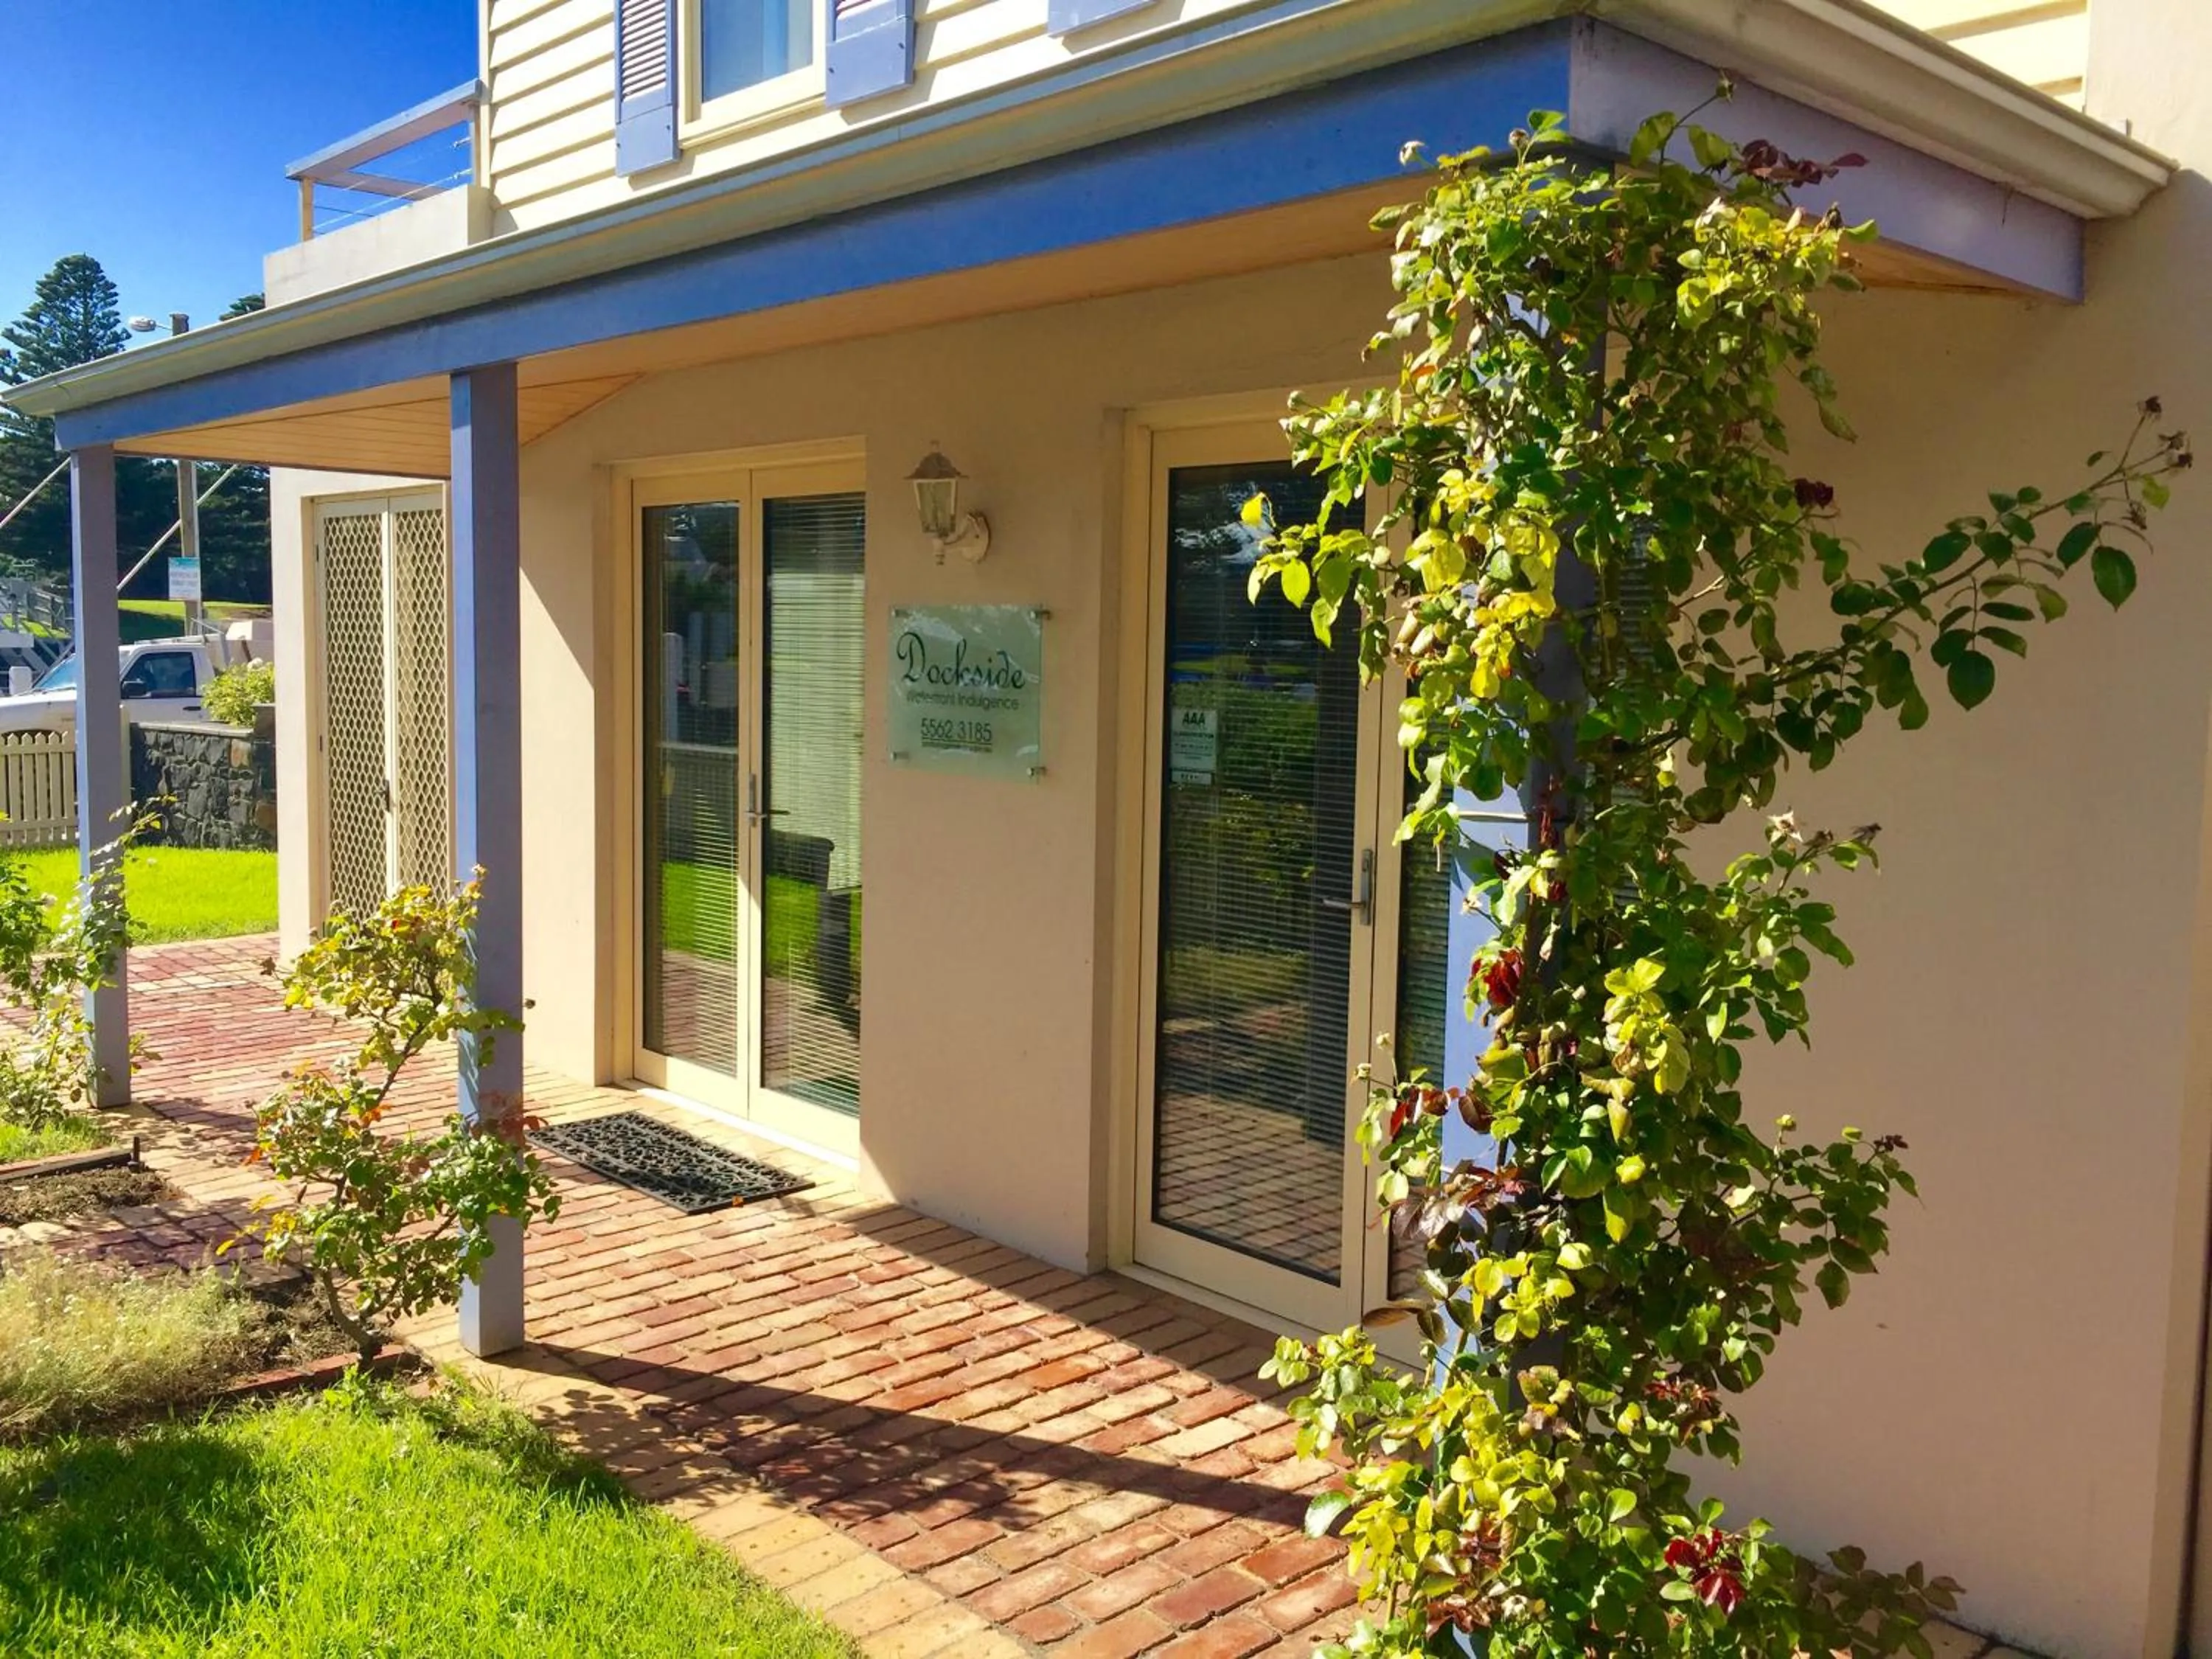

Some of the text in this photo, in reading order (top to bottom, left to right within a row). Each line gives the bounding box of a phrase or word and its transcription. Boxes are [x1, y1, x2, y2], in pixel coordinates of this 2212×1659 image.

[896, 631, 1026, 689] Dockside
[922, 717, 992, 742] 5562 3185
